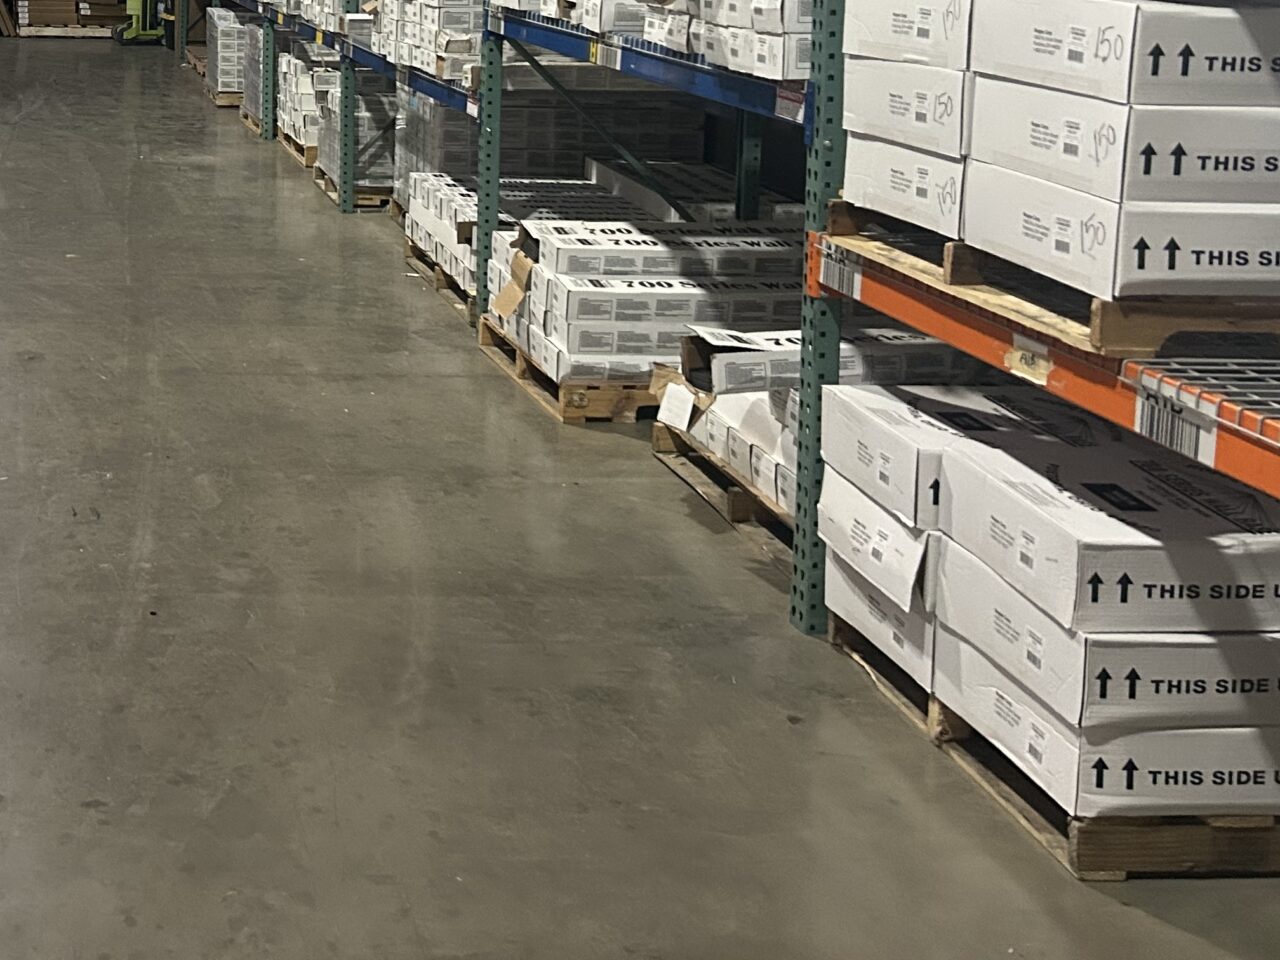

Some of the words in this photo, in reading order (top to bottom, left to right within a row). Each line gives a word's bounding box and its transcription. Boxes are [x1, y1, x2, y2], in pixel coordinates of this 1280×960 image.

[1094, 25, 1124, 62] 150
[1205, 56, 1261, 73] THIS
[1197, 155, 1257, 172] THIS
[583, 227, 633, 236] 700
[607, 239, 659, 247] 700
[740, 239, 793, 248] Wall
[1192, 250, 1253, 267] THIS
[620, 280, 674, 289] 700
[1144, 583, 1200, 599] THIS
[1209, 583, 1266, 599] SIDE
[1151, 678, 1207, 695] THIS
[1216, 678, 1271, 694] SIDE
[1148, 770, 1204, 786] THIS
[1212, 769, 1267, 785] SIDE
